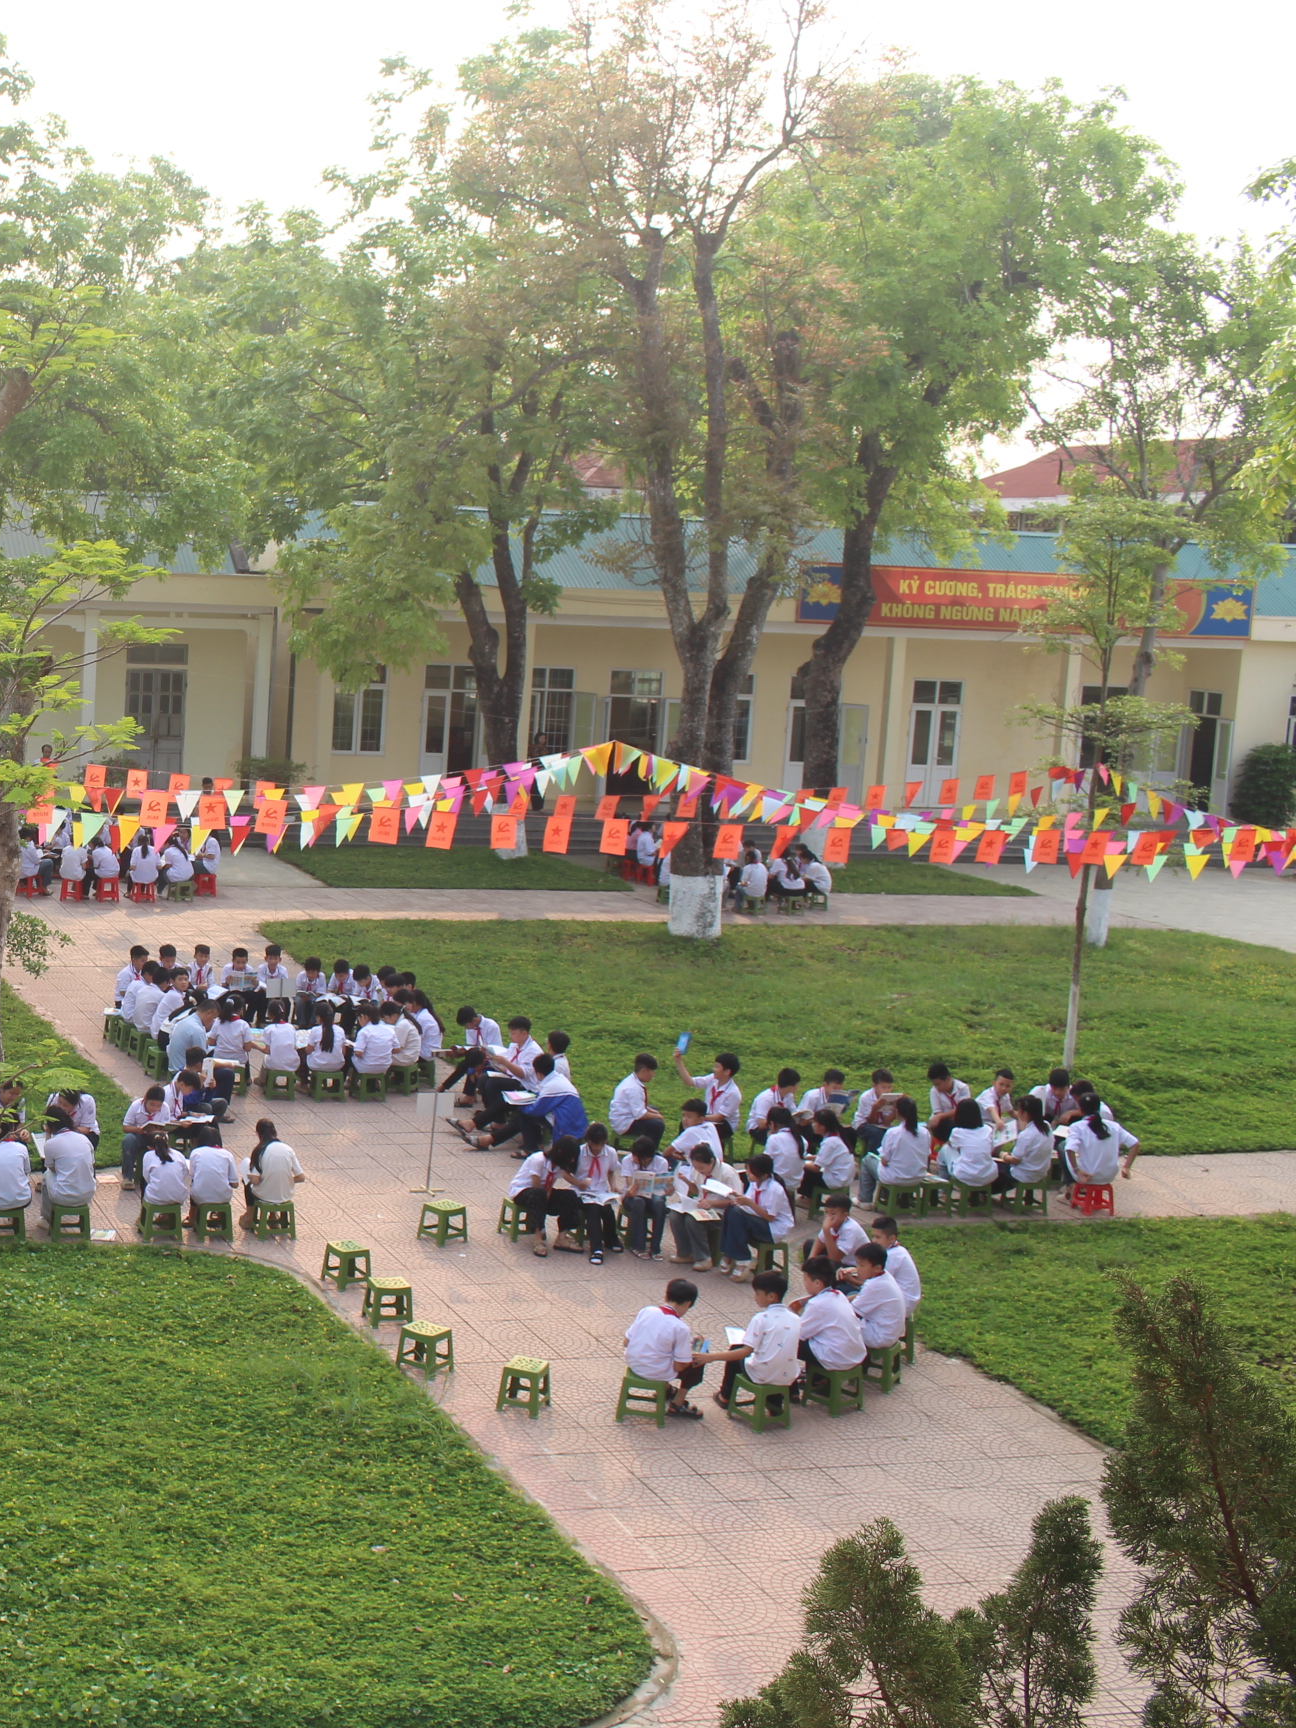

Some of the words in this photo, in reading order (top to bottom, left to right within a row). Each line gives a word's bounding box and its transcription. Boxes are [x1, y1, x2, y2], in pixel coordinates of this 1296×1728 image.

[899, 575, 920, 595] KỶ
[924, 580, 982, 598] CƯƠNG,
[881, 600, 935, 619] KHÔNG
[939, 603, 995, 621] NGỪNG
